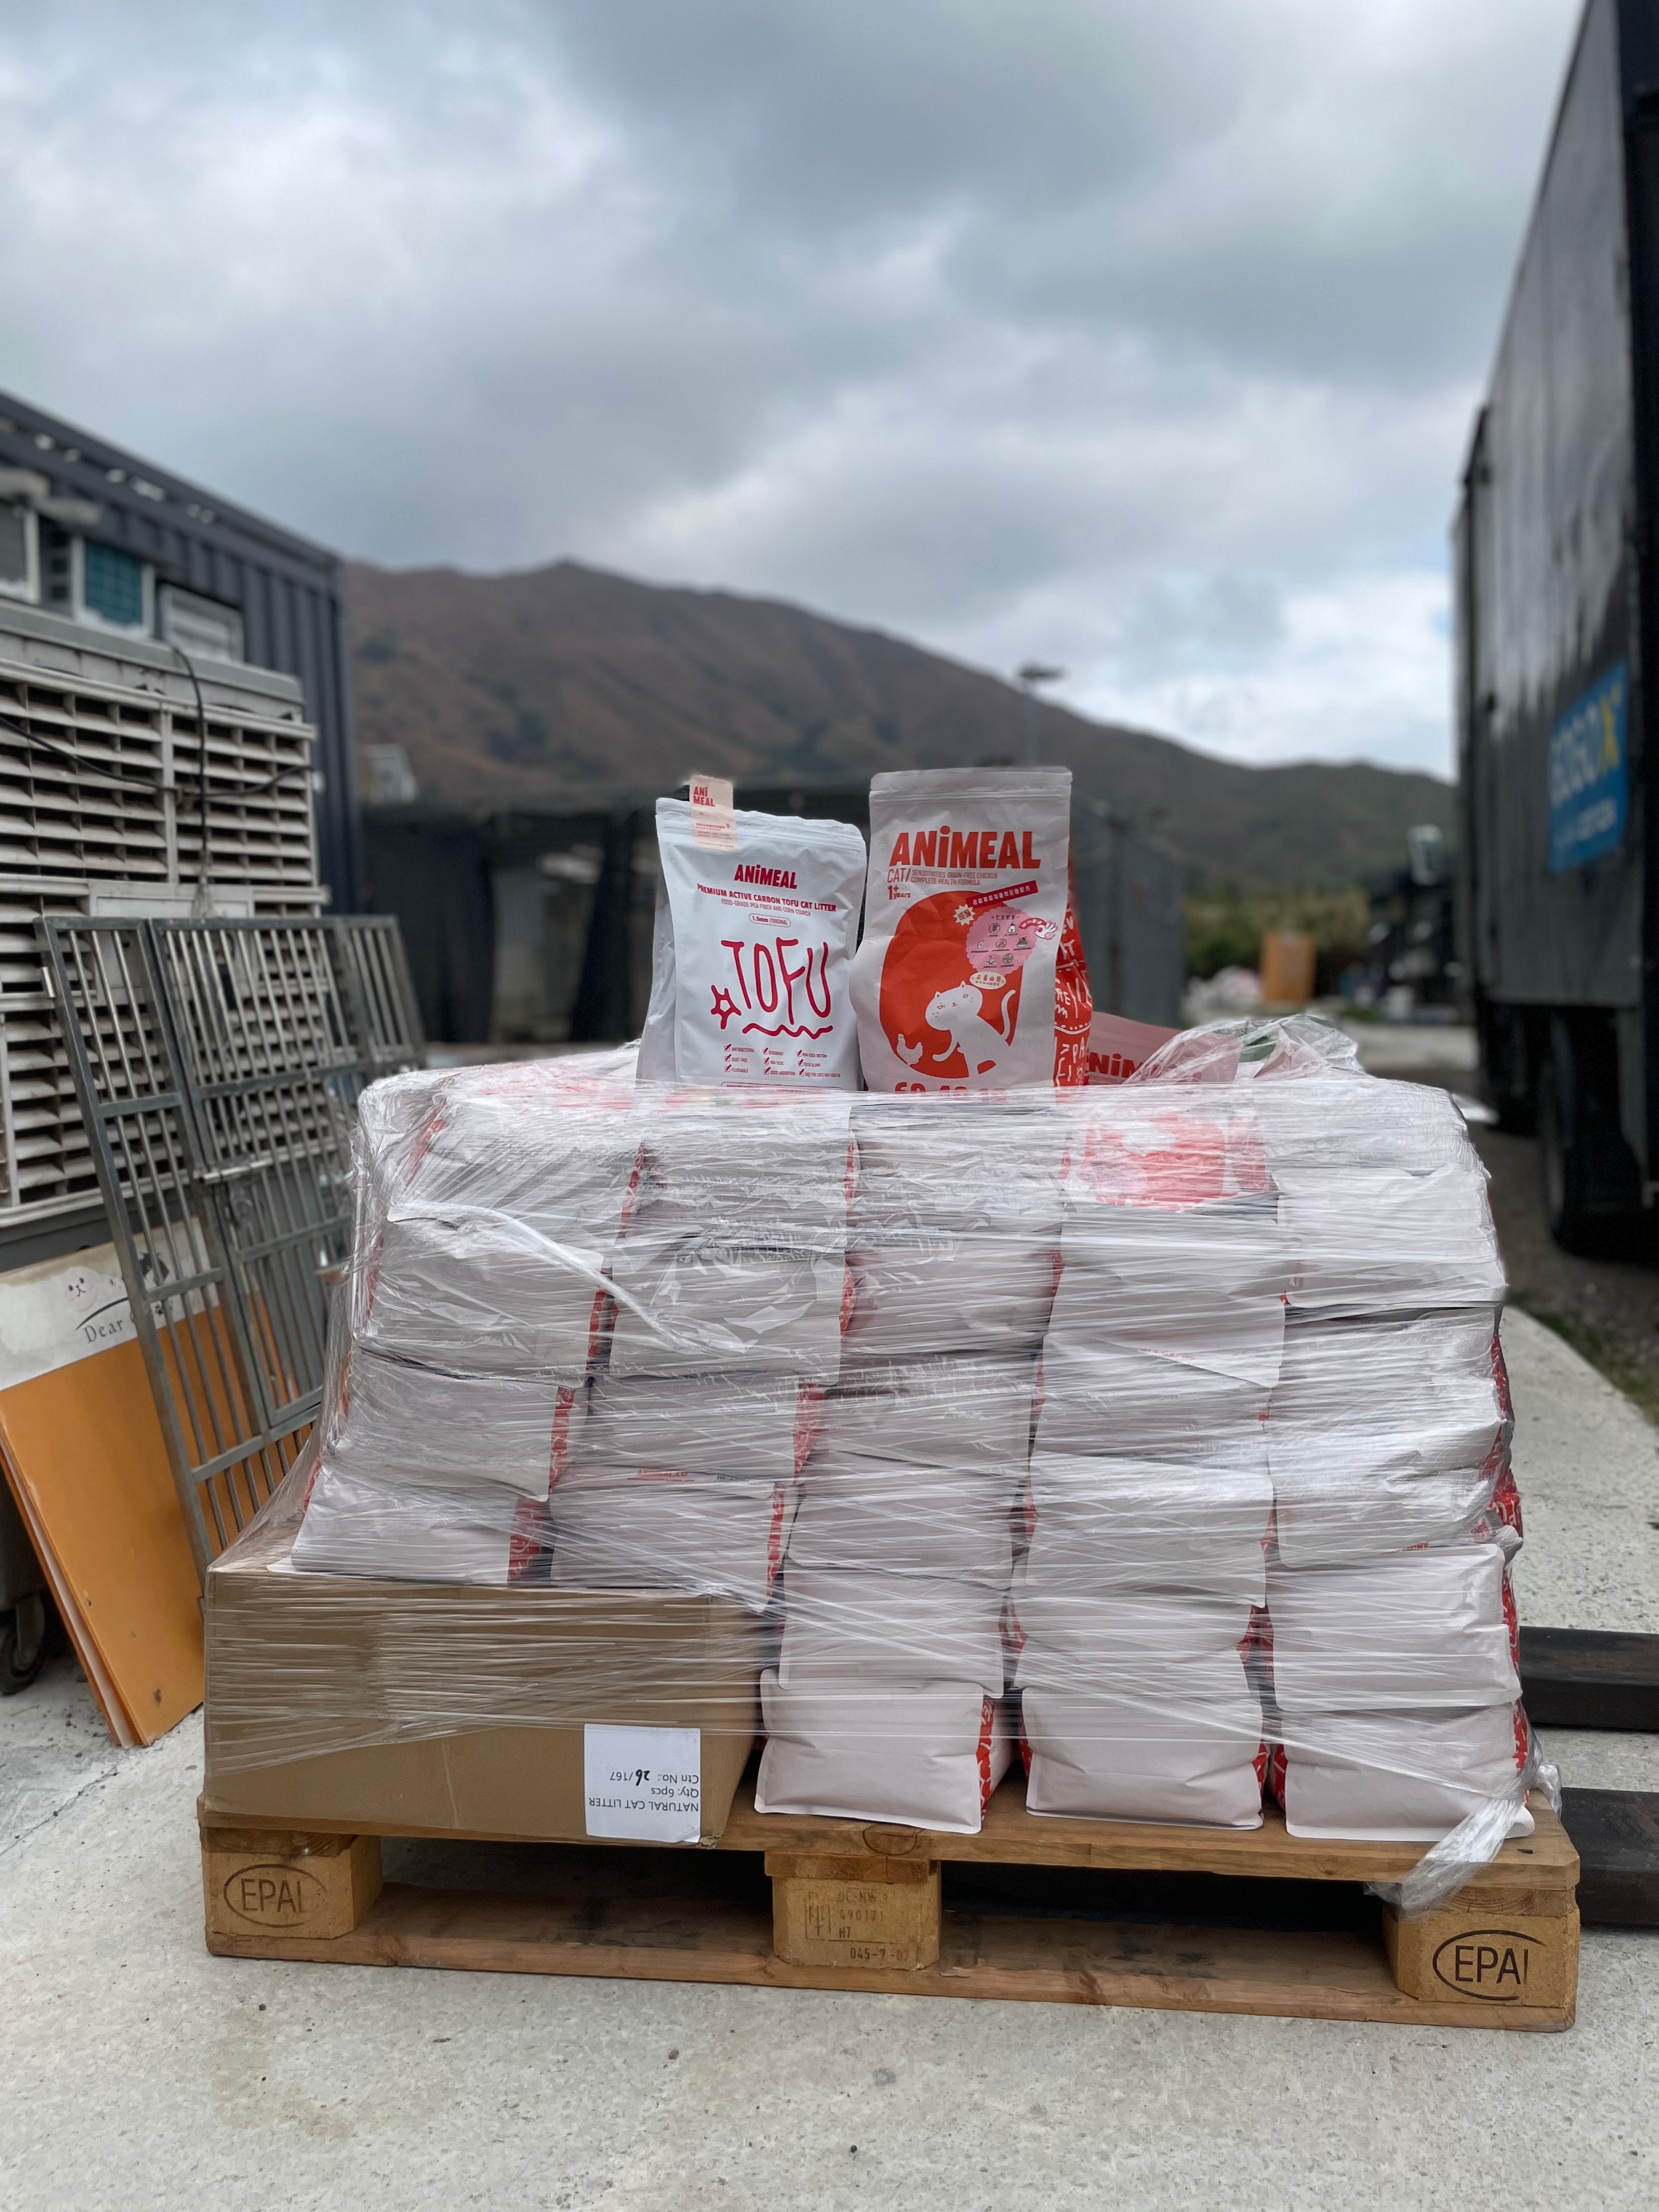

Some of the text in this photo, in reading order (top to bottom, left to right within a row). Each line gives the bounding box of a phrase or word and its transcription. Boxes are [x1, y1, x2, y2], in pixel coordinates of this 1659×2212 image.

[693, 795, 715, 807] MEAL
[911, 876, 937, 884] COMPLETE
[697, 883, 836, 912] PREMIUM ACTIVE CARBON TOFU CAT LITTER
[721, 937, 831, 1025] TOFU
[82, 1317, 124, 1343] Dear
[681, 1775, 699, 1784] Ctn
[651, 1786, 699, 1798] Qty: 6pcs
[588, 1797, 699, 1812] NATURAL CAT LITTER
